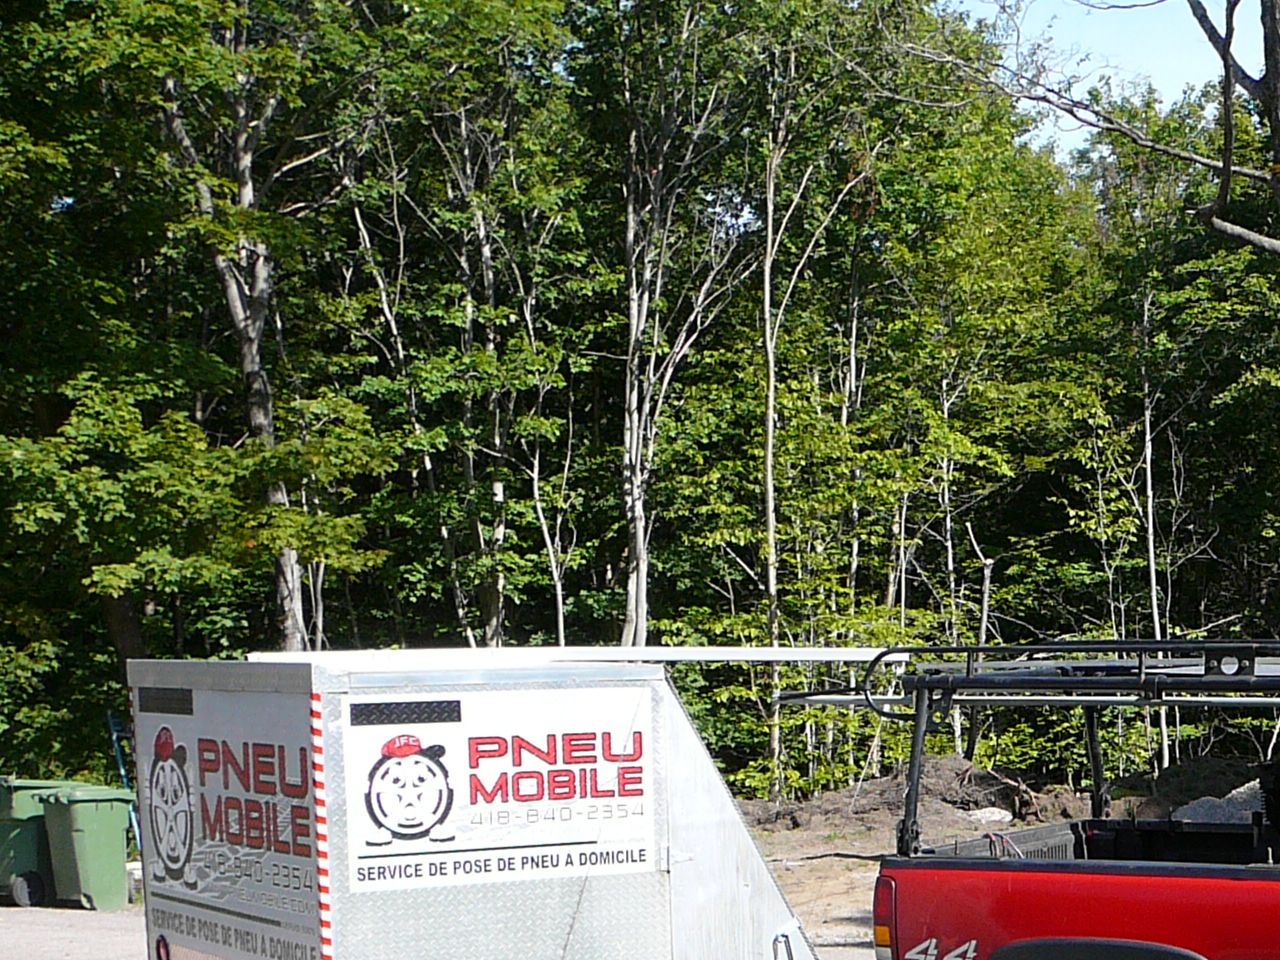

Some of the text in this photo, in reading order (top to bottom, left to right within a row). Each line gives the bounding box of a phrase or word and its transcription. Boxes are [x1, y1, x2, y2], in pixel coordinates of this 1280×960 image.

[197, 738, 308, 800] PNEU
[468, 731, 643, 769] PNEU
[469, 766, 644, 805] MOBILE
[200, 793, 312, 858] MOBILE
[470, 803, 644, 825] 418-840-2354
[357, 863, 424, 881] SERVICE
[428, 862, 448, 877] DE
[453, 858, 492, 875] POSE
[497, 857, 516, 872] DE
[521, 853, 560, 870] PNEU
[579, 849, 647, 866] DOMICILE
[151, 907, 185, 935] SERVICE
[185, 914, 197, 938] DE
[198, 918, 220, 944] POSE
[221, 924, 233, 948] DE
[233, 928, 258, 954] PNEU
